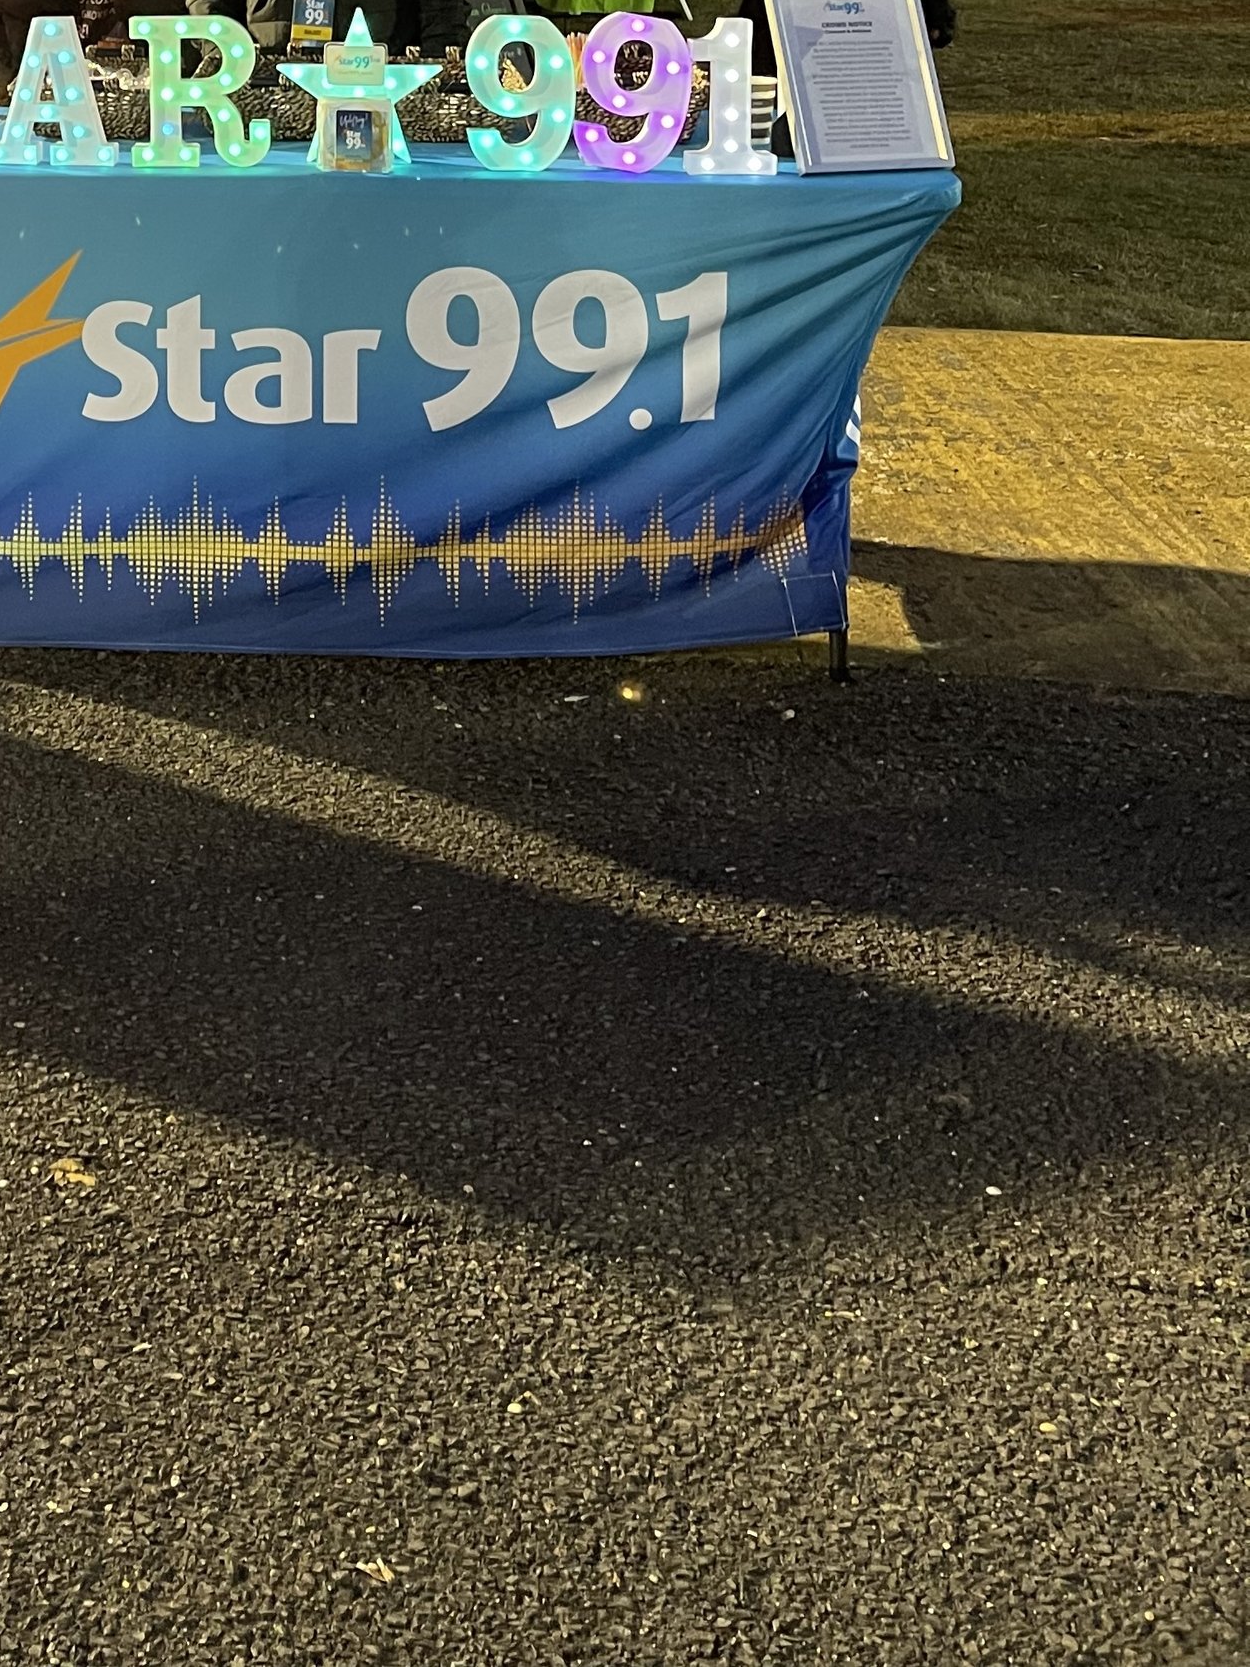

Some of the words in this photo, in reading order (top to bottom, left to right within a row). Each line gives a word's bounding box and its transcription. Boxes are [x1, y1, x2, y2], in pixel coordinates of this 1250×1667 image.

[466, 11, 778, 176] 991
[81, 294, 382, 425] Star
[406, 266, 729, 432] 99.1
